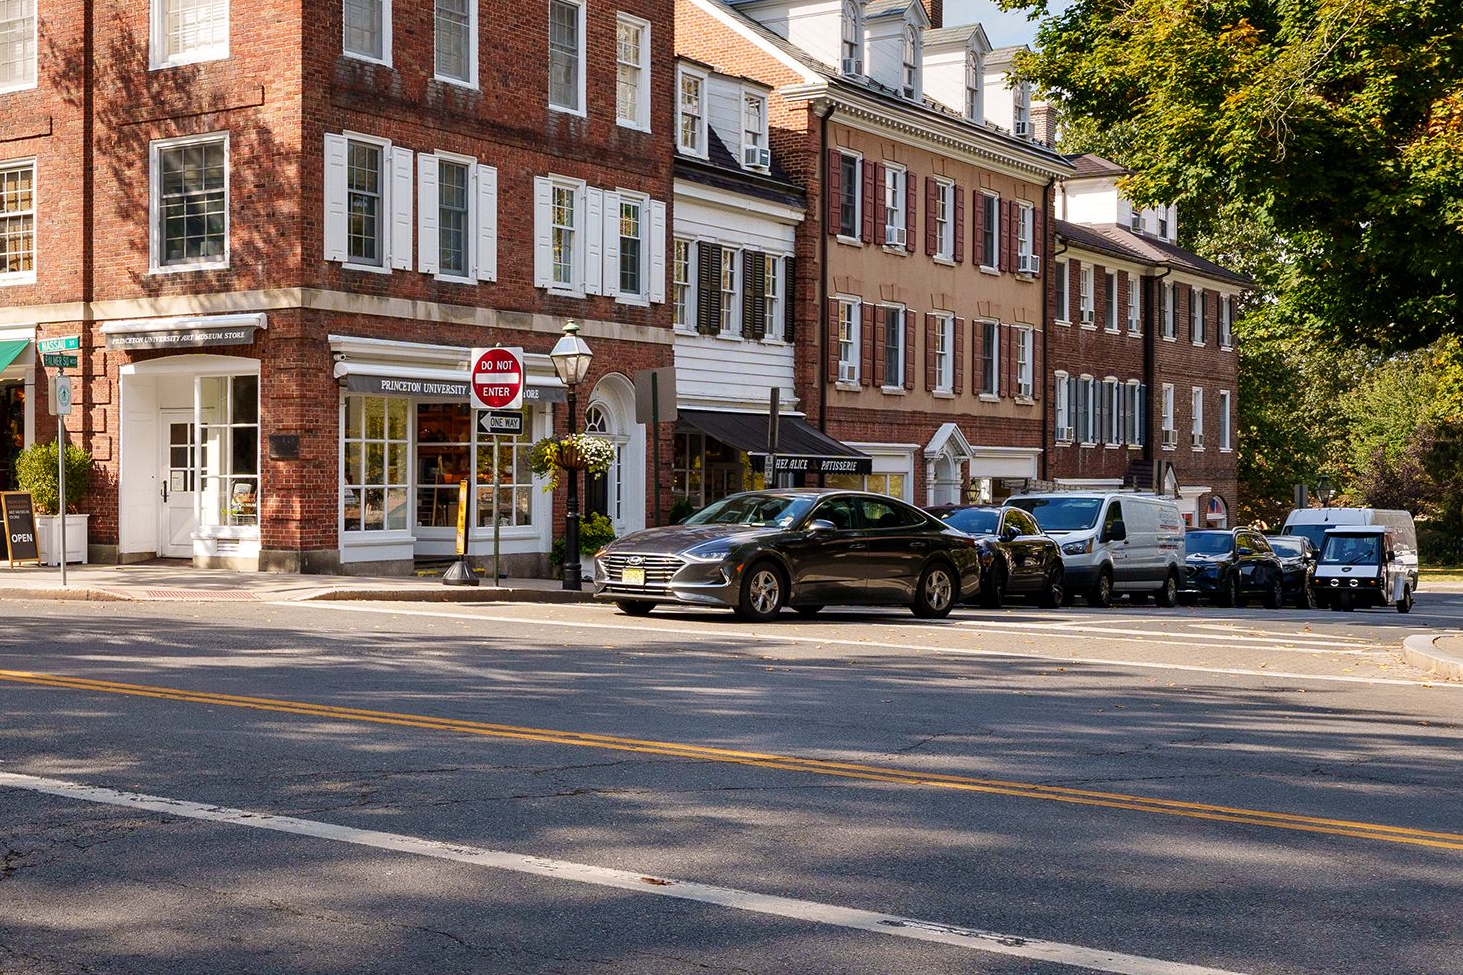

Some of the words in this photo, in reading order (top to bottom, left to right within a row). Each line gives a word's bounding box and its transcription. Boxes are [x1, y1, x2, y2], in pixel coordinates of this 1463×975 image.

[112, 337, 143, 345] PRINCETON
[144, 335, 180, 344] UNIVERSITY
[181, 334, 194, 342] ART
[194, 332, 223, 341] MUSEUM
[224, 331, 245, 340] STORE
[41, 339, 65, 351] NASSAU
[62, 356, 69, 366] SQ
[481, 361, 493, 370] DO
[496, 360, 513, 370] NOT
[381, 380, 422, 392] PRINCETON
[423, 383, 467, 395] UNIVERSITY
[483, 387, 510, 397] ENTER
[490, 417, 503, 427] ONE
[504, 418, 519, 428] WAY
[775, 459, 789, 469] HEZ
[789, 459, 808, 470] ALICE
[820, 460, 858, 472] PATISSERIE
[11, 533, 33, 543] OPEN
